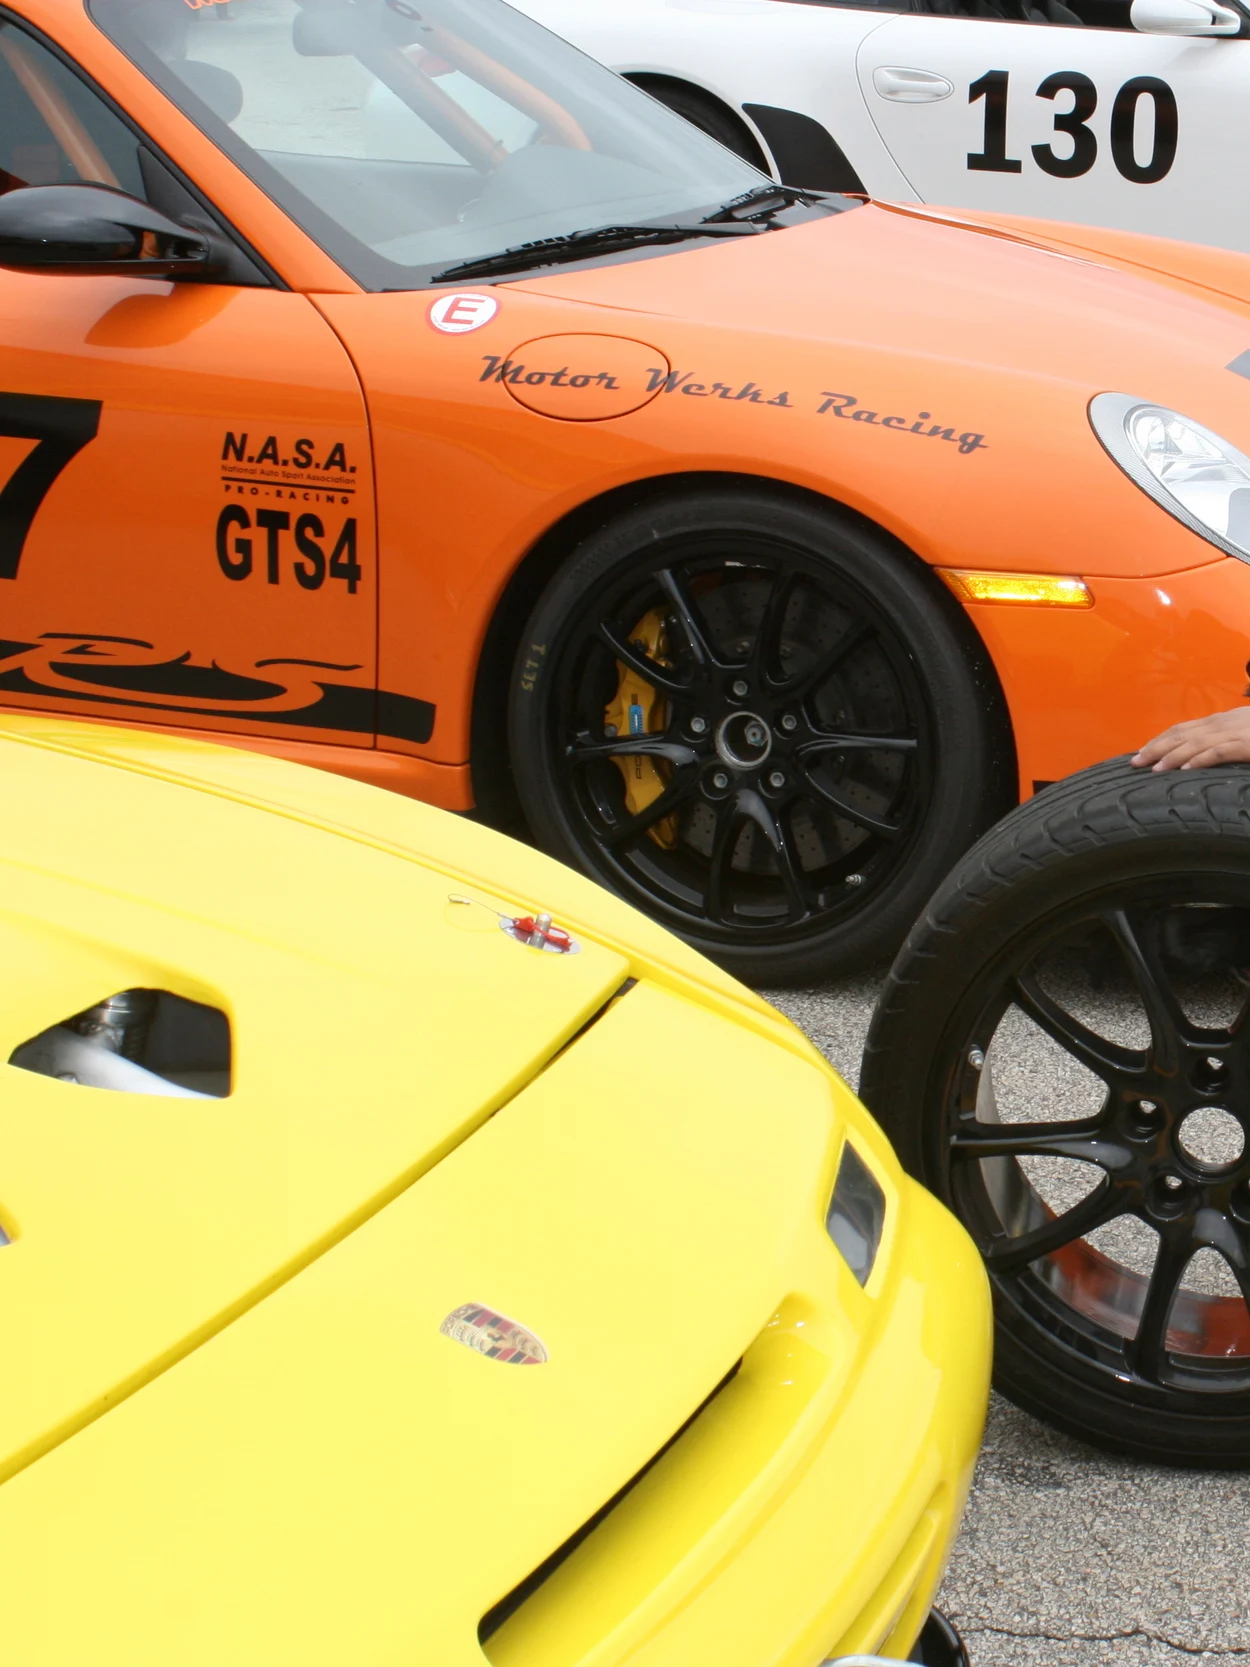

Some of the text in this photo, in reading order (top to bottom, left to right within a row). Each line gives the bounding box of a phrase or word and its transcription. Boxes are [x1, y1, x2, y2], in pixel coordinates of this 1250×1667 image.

[966, 69, 1180, 184] 130
[441, 296, 486, 325] E
[479, 356, 988, 454] Motor Werks Racing
[221, 431, 357, 473] N.A.S.A.
[221, 465, 356, 485] National Auto Sport Association
[224, 484, 350, 505] PRO-RACING
[216, 503, 361, 595] GTS4
